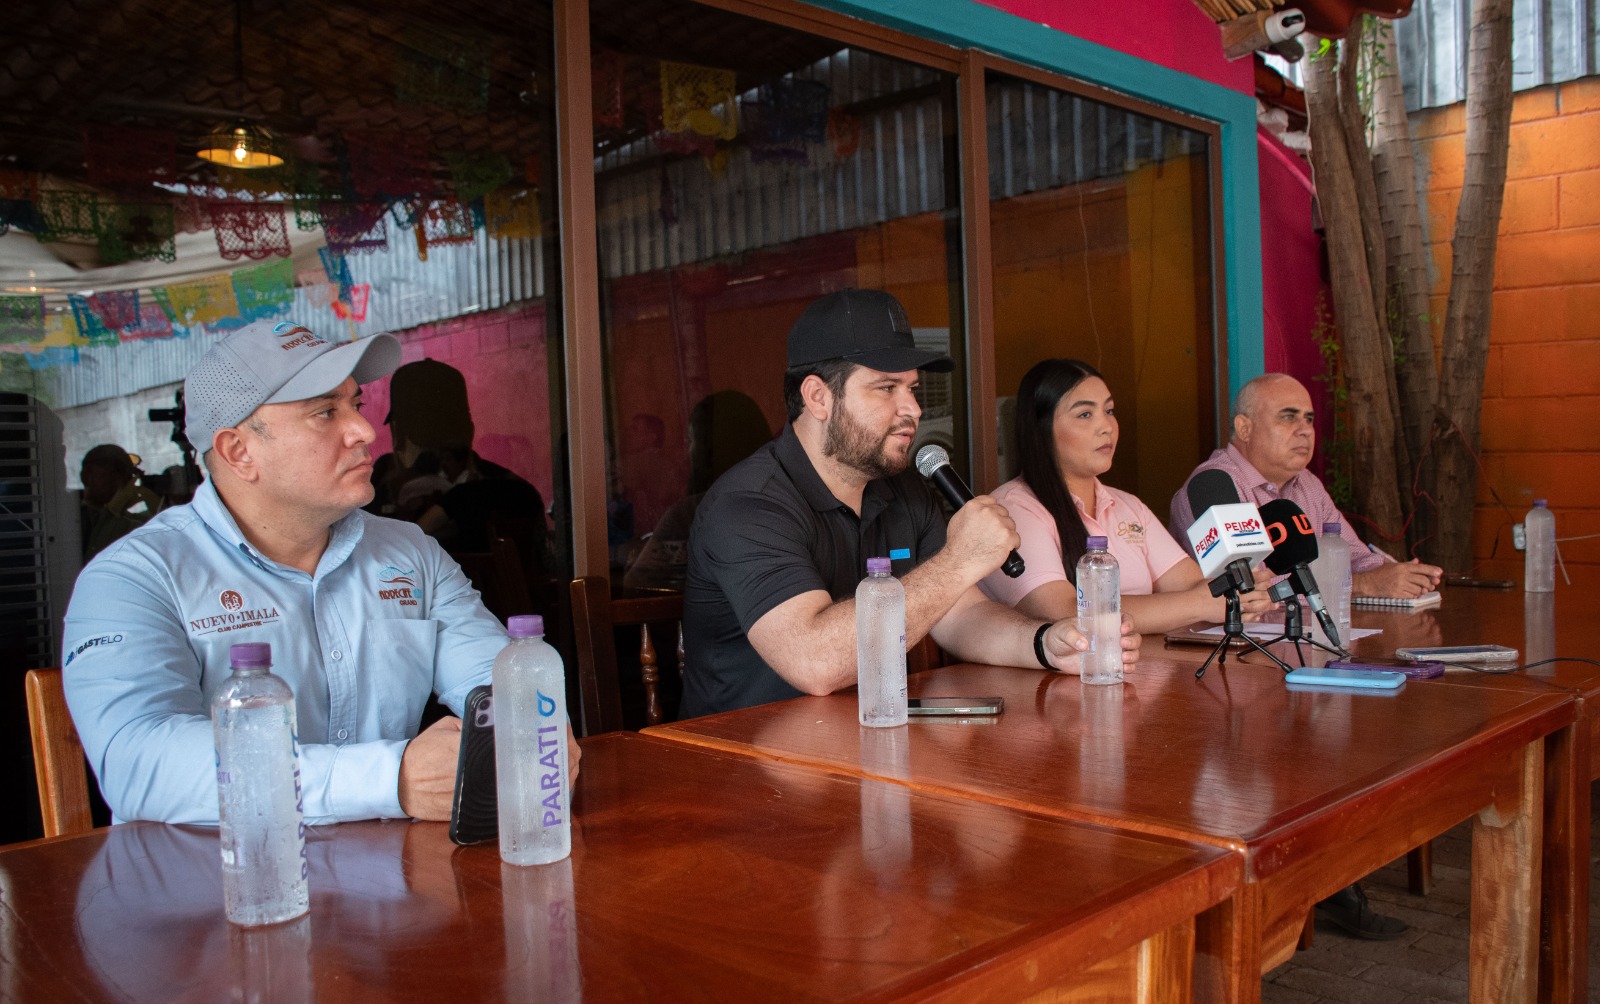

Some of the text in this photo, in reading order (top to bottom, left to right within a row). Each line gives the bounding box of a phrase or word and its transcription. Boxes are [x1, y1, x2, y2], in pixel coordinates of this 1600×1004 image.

[190, 607, 280, 631] NUEVO IMALA
[537, 725, 562, 827] PARATI
